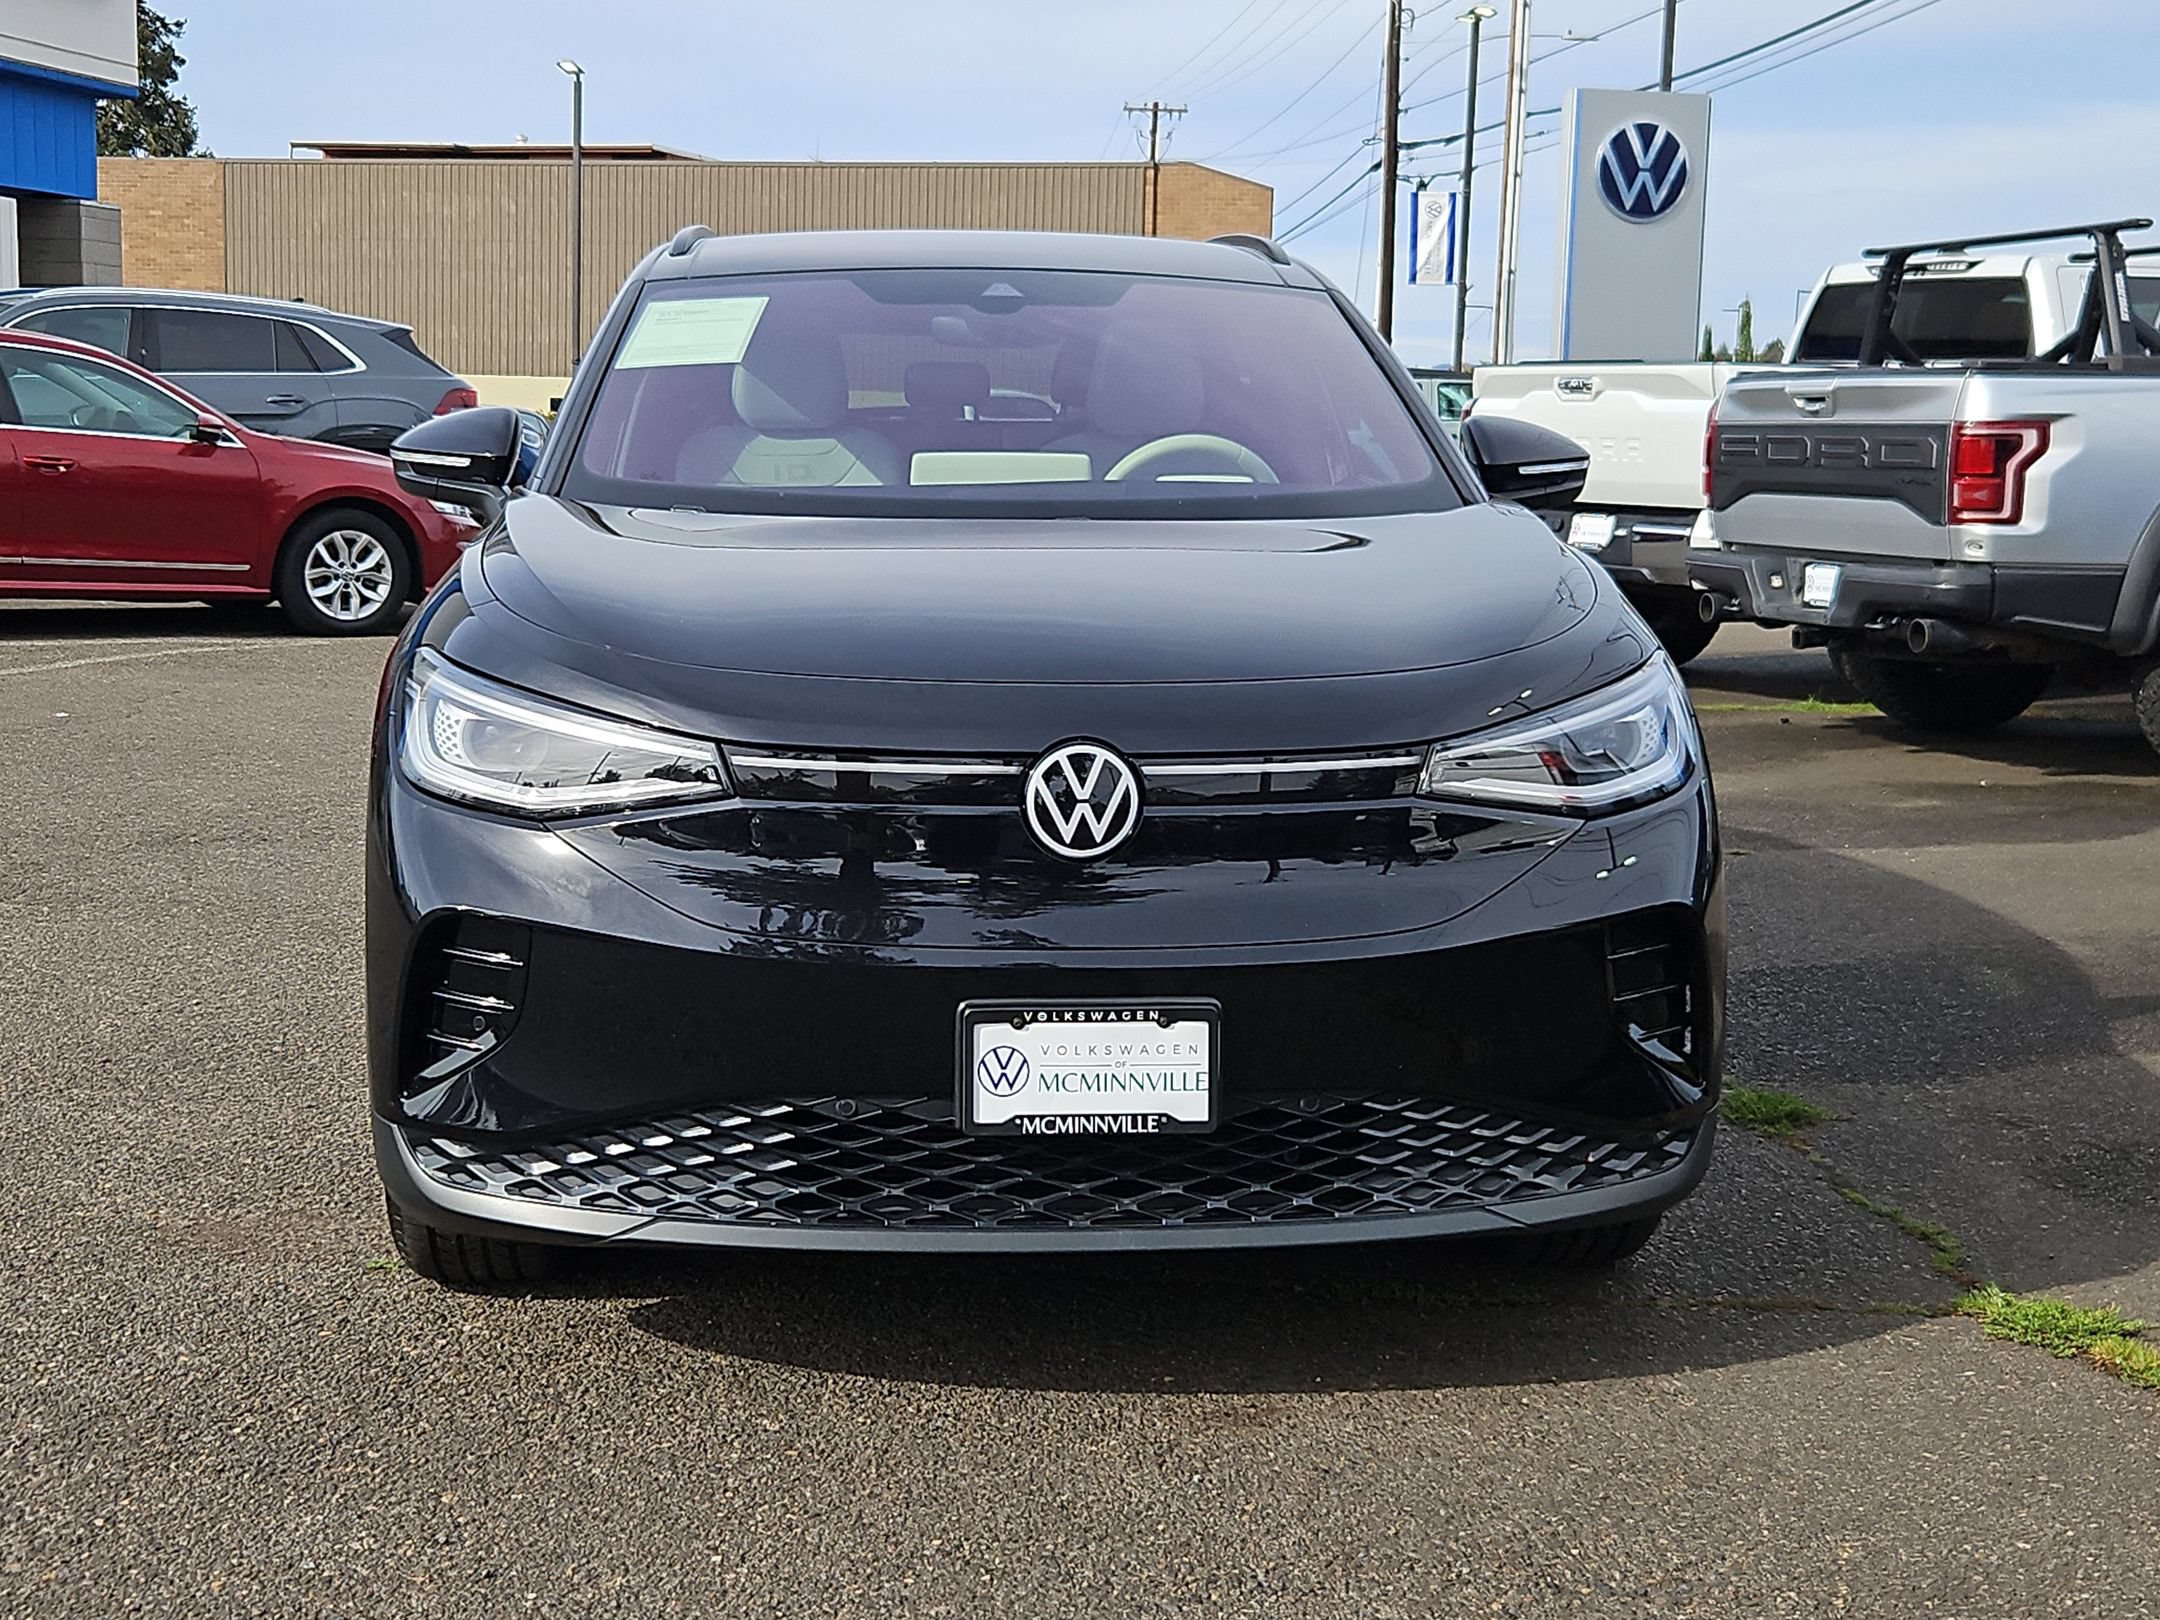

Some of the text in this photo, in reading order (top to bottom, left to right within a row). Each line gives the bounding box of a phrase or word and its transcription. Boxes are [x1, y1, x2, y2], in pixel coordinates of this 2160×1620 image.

[1719, 434, 1939, 468] FORD
[1023, 1010, 1159, 1022] VOLKSWAGEN
[1040, 1044, 1199, 1056] VOLKSWAGEN
[1114, 1060, 1127, 1069] OF
[1038, 1072, 1209, 1093] MCMINNVILLE
[1022, 1116, 1160, 1135] MCMINNVILLE
